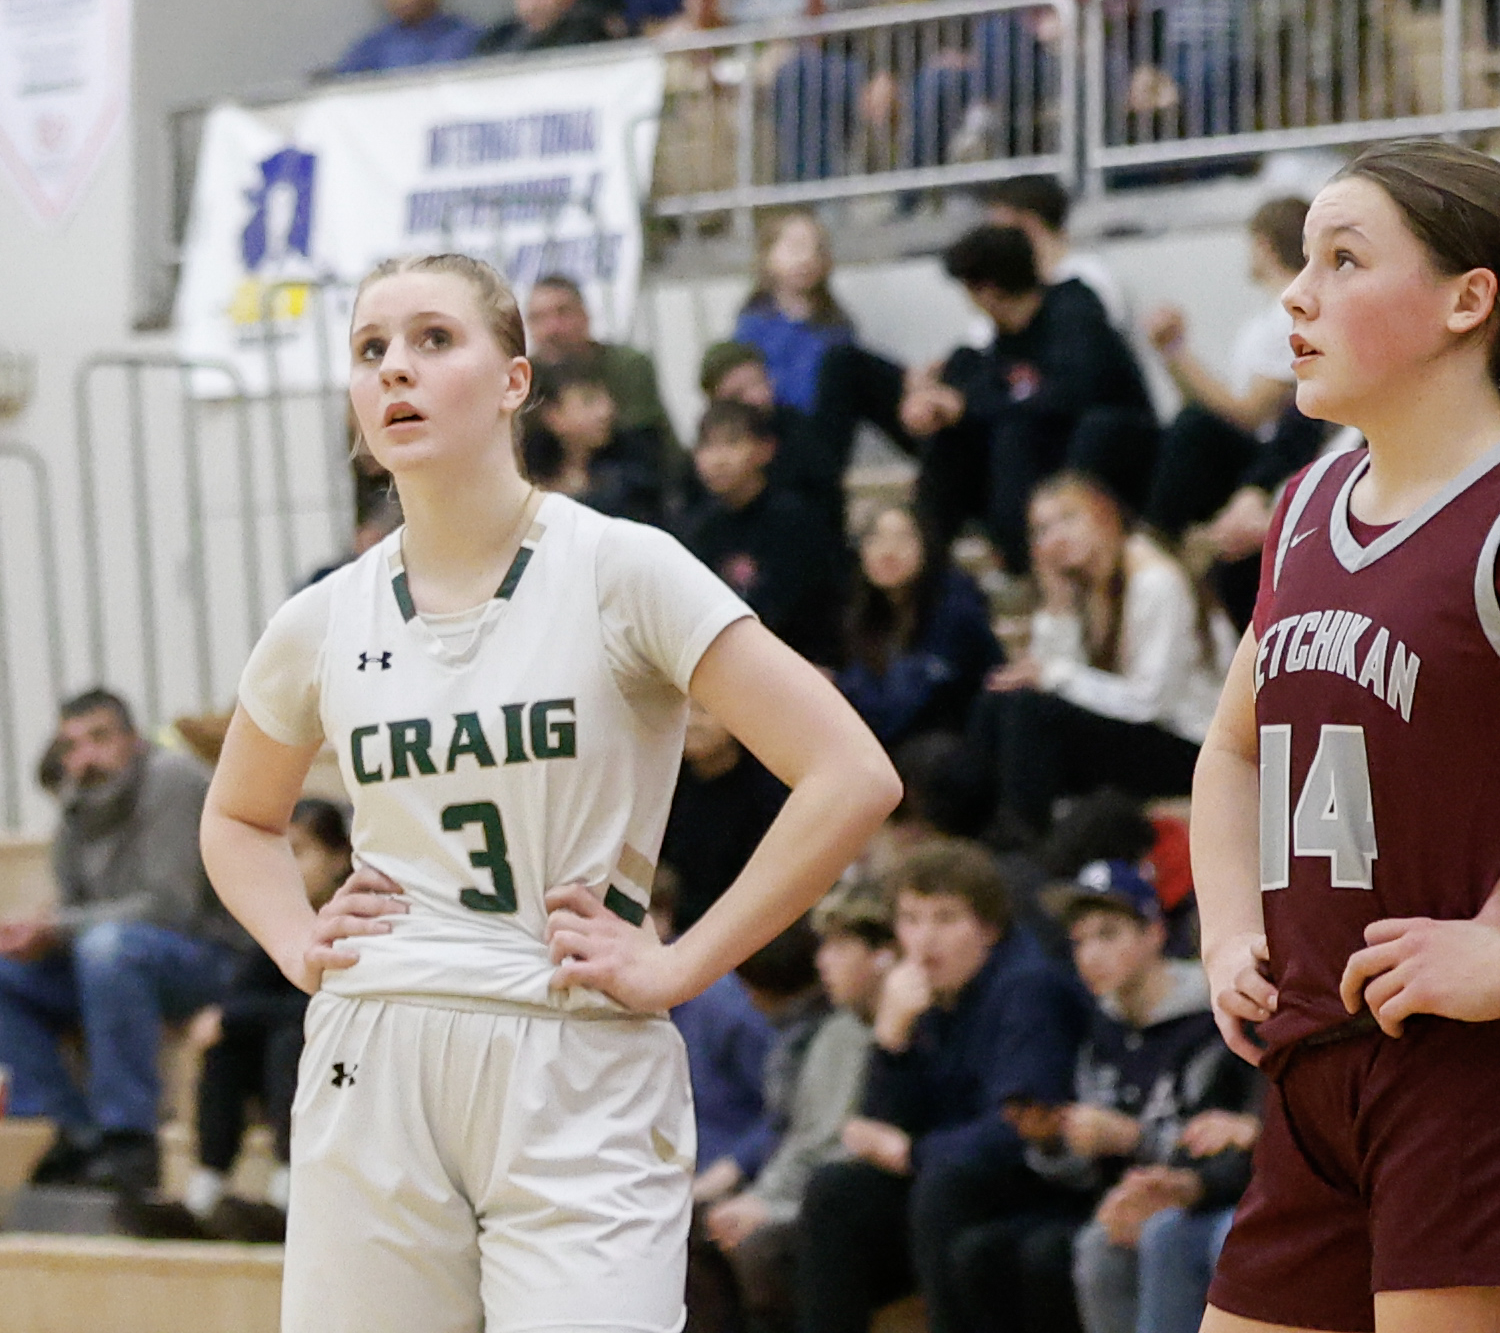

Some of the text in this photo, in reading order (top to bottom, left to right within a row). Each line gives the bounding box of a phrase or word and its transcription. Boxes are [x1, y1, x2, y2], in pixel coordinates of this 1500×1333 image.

[1254, 609, 1421, 723] ETCHIKAN
[349, 697, 577, 786] CRAIG
[440, 800, 518, 914] 3
[1259, 723, 1378, 892] 14
